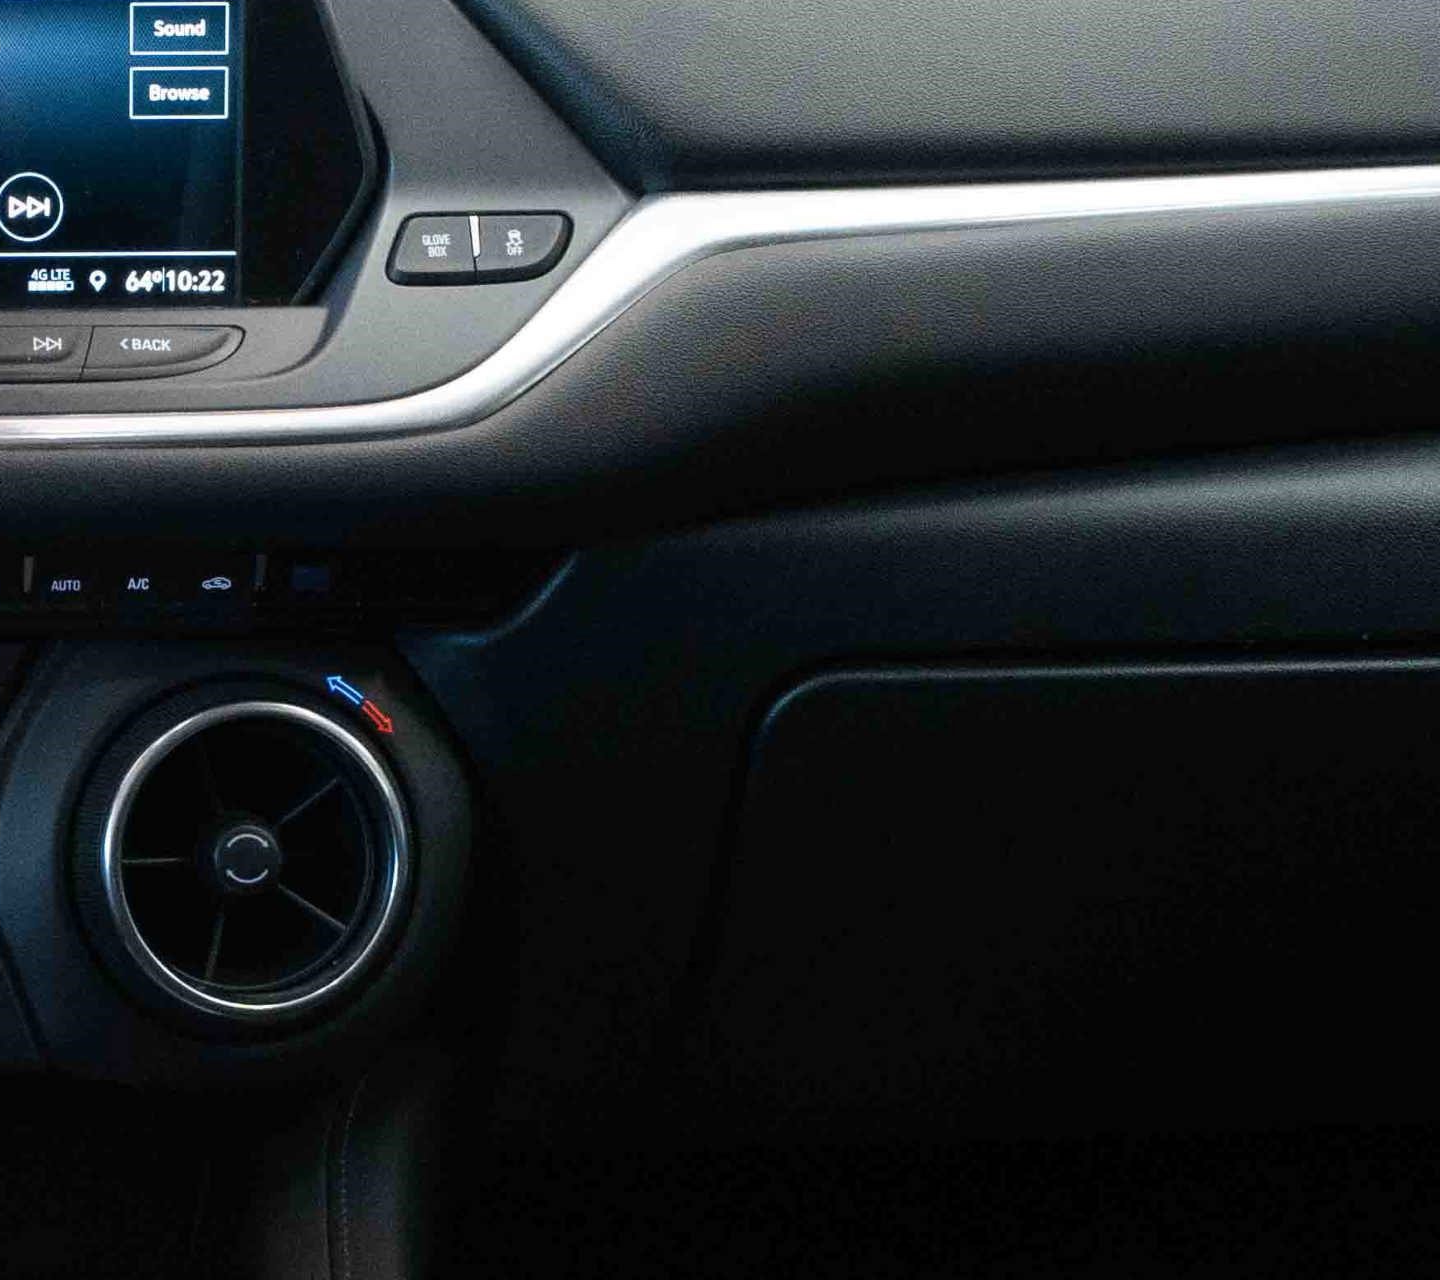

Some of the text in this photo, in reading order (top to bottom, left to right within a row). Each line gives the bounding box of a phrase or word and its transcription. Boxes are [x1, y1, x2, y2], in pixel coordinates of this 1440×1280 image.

[153, 19, 206, 37] Sound
[149, 83, 210, 102] Browse
[422, 233, 452, 246] GLOVE
[427, 245, 448, 258] BOX
[506, 245, 524, 257] OFF
[30, 268, 71, 280] 4G LTE
[165, 269, 225, 292] 10:22
[131, 338, 171, 352] BACK
[51, 578, 81, 593] AUTO
[127, 577, 150, 591] A/C
